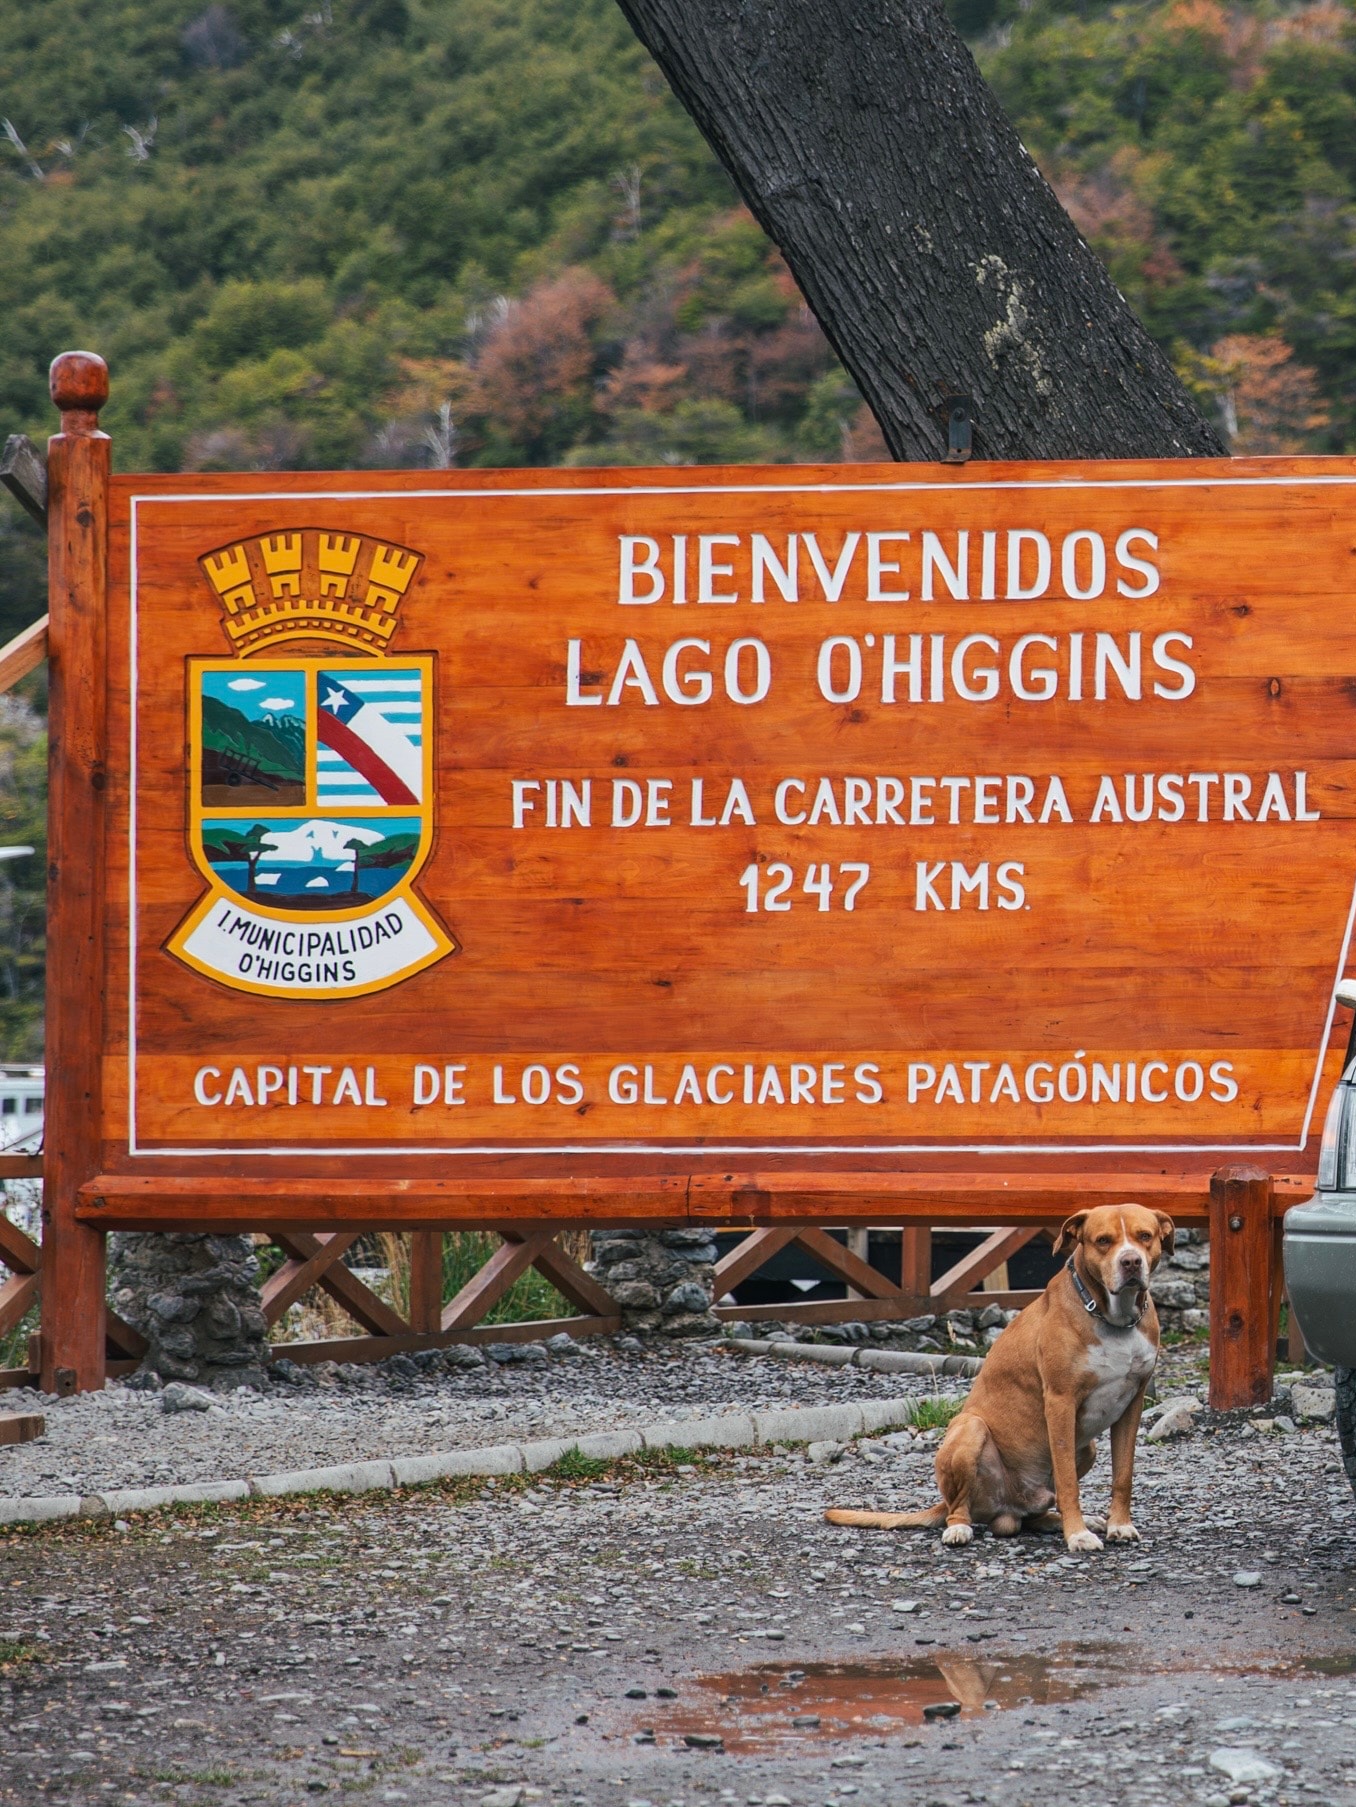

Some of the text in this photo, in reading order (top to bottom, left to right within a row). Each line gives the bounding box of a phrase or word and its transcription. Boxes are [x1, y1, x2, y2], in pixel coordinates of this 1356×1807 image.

[617, 528, 1160, 605] BIENVENIDOS
[565, 631, 1197, 706] LAGO O'HIGGINS
[511, 771, 1321, 829] FIN DE LA CARRETERA AUSTRAL
[738, 862, 870, 913] 1247
[238, 953, 357, 983] O'HIGGINS
[193, 1048, 1240, 1107] CAPITAL DE LOS GLACIARES PATAGÓNICOS
